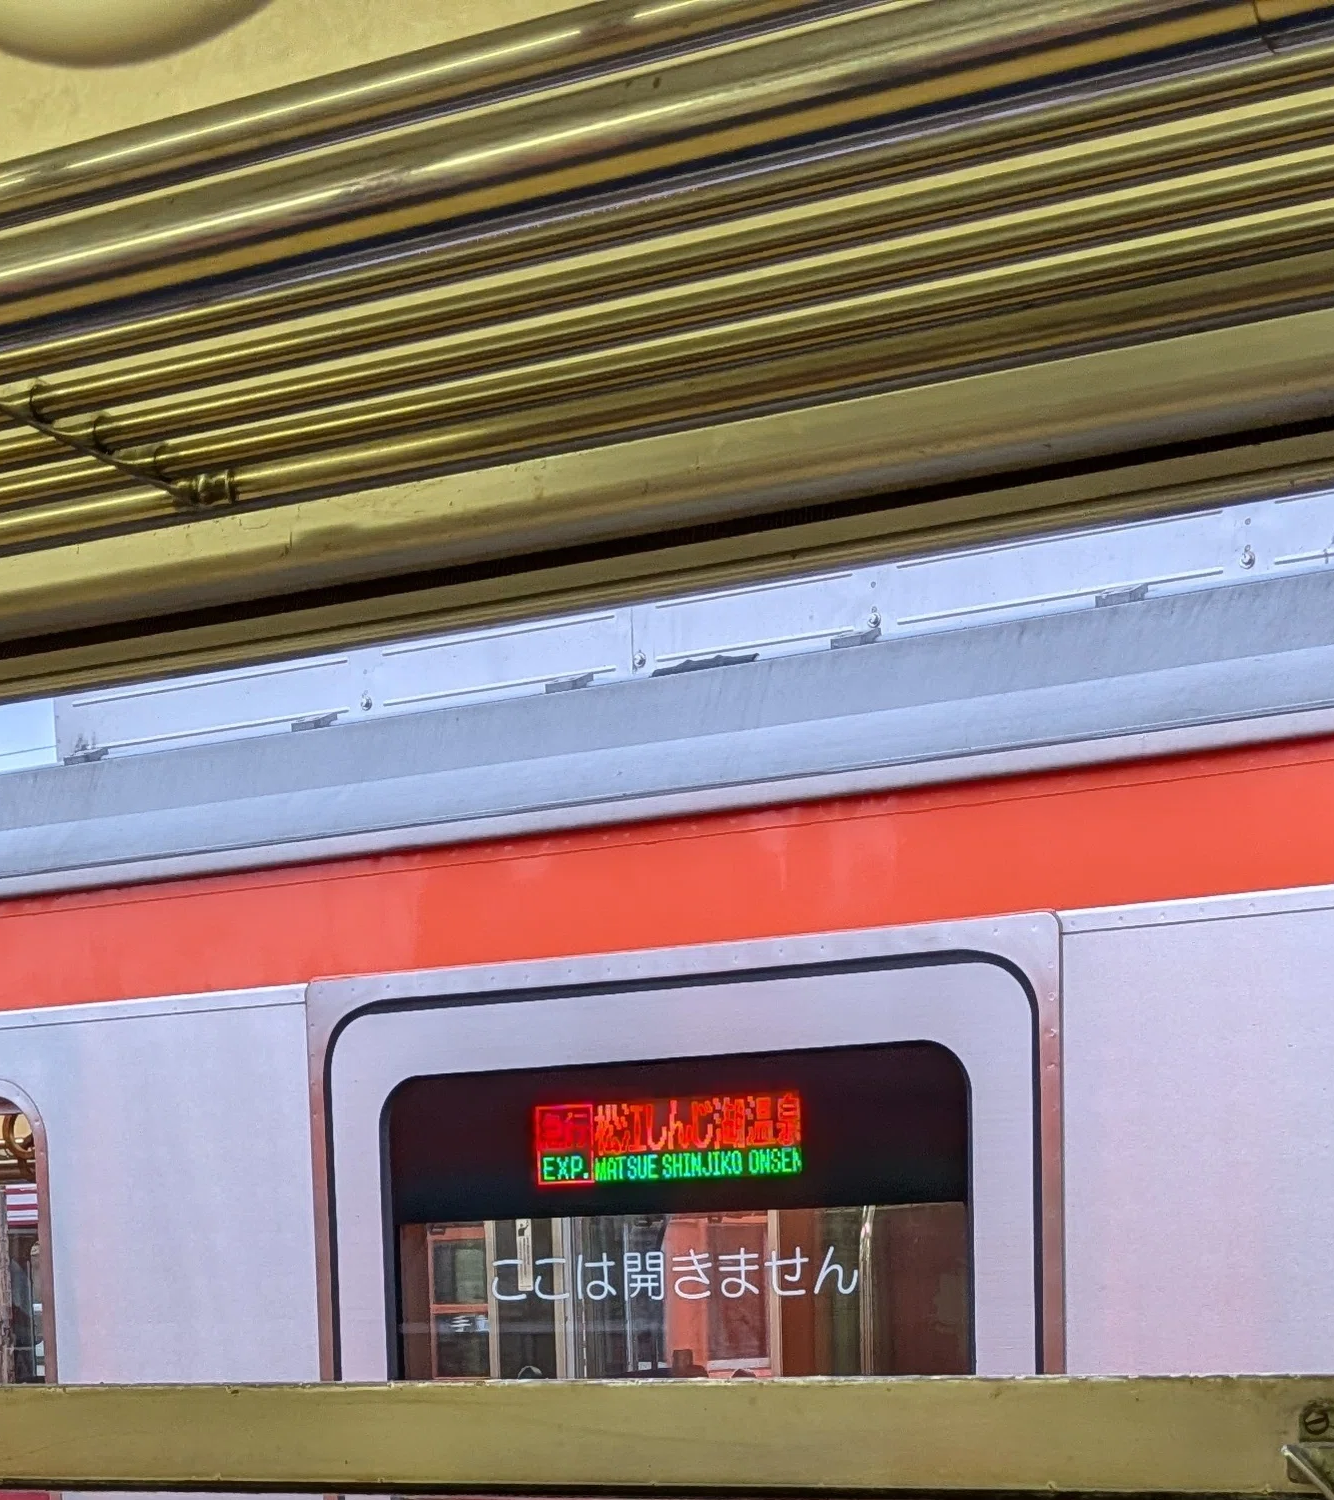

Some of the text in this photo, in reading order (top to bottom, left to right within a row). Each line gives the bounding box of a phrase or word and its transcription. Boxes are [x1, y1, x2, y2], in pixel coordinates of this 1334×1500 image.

[543, 1147, 802, 1181] EXP. MATSUE SHINJIKO ONSEN
[490, 1245, 860, 1302] ここは開きません
